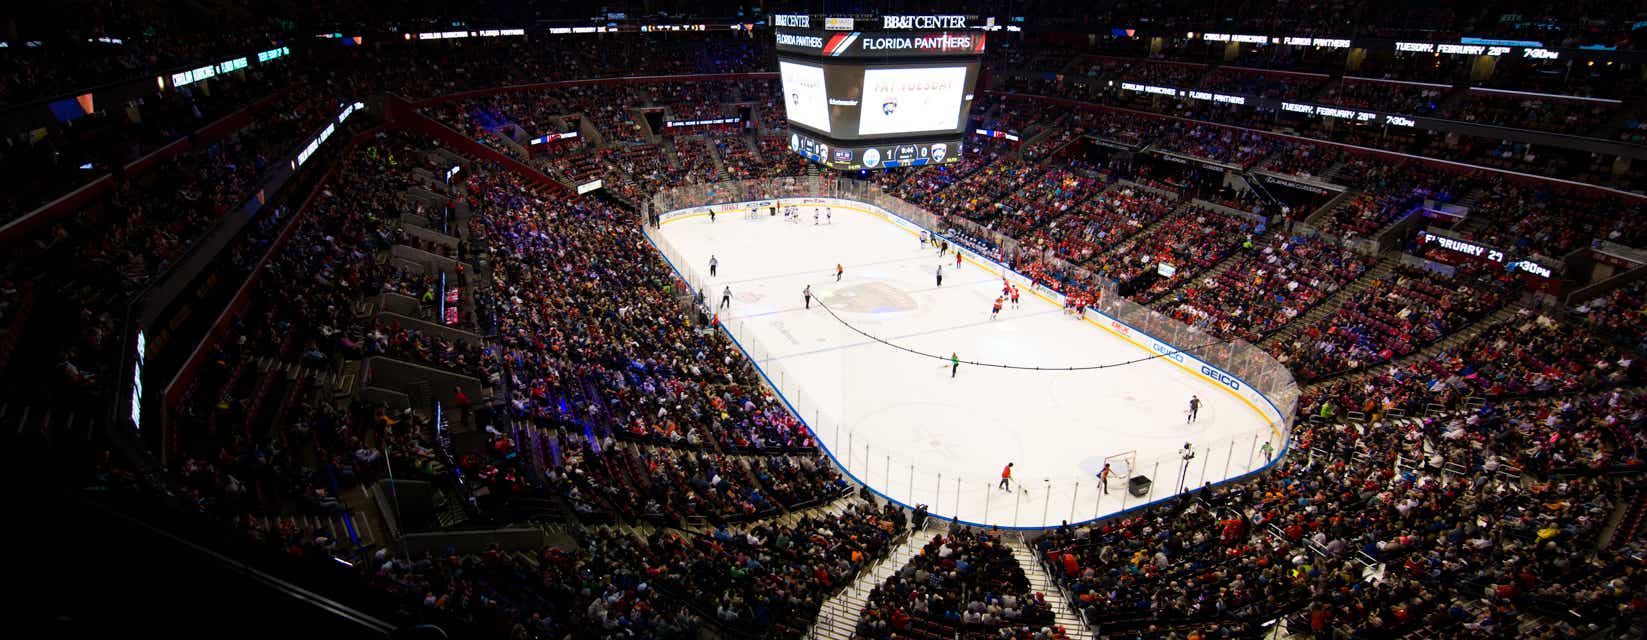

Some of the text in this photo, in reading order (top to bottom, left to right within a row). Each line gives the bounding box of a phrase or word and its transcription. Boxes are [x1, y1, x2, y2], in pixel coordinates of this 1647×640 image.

[883, 15, 915, 29] BB&T
[915, 15, 967, 29] CENTER
[776, 34, 823, 49] FLORIDA PANTHERS
[863, 36, 971, 50] FLORIDA PANTHERS
[1231, 35, 1267, 43] HURRICANES
[1284, 37, 1311, 45] FLORIDA
[1313, 39, 1350, 48] PANTHERS
[1436, 44, 1484, 56] FEBRUARY
[1189, 91, 1212, 100] FLORIDA
[1214, 94, 1244, 104] PANTHERS
[1316, 107, 1355, 118] FEBRUARY
[886, 150, 892, 160] 1
[921, 147, 928, 157] 0
[1152, 342, 1184, 363] GEICO
[1201, 366, 1240, 390] GEICO
